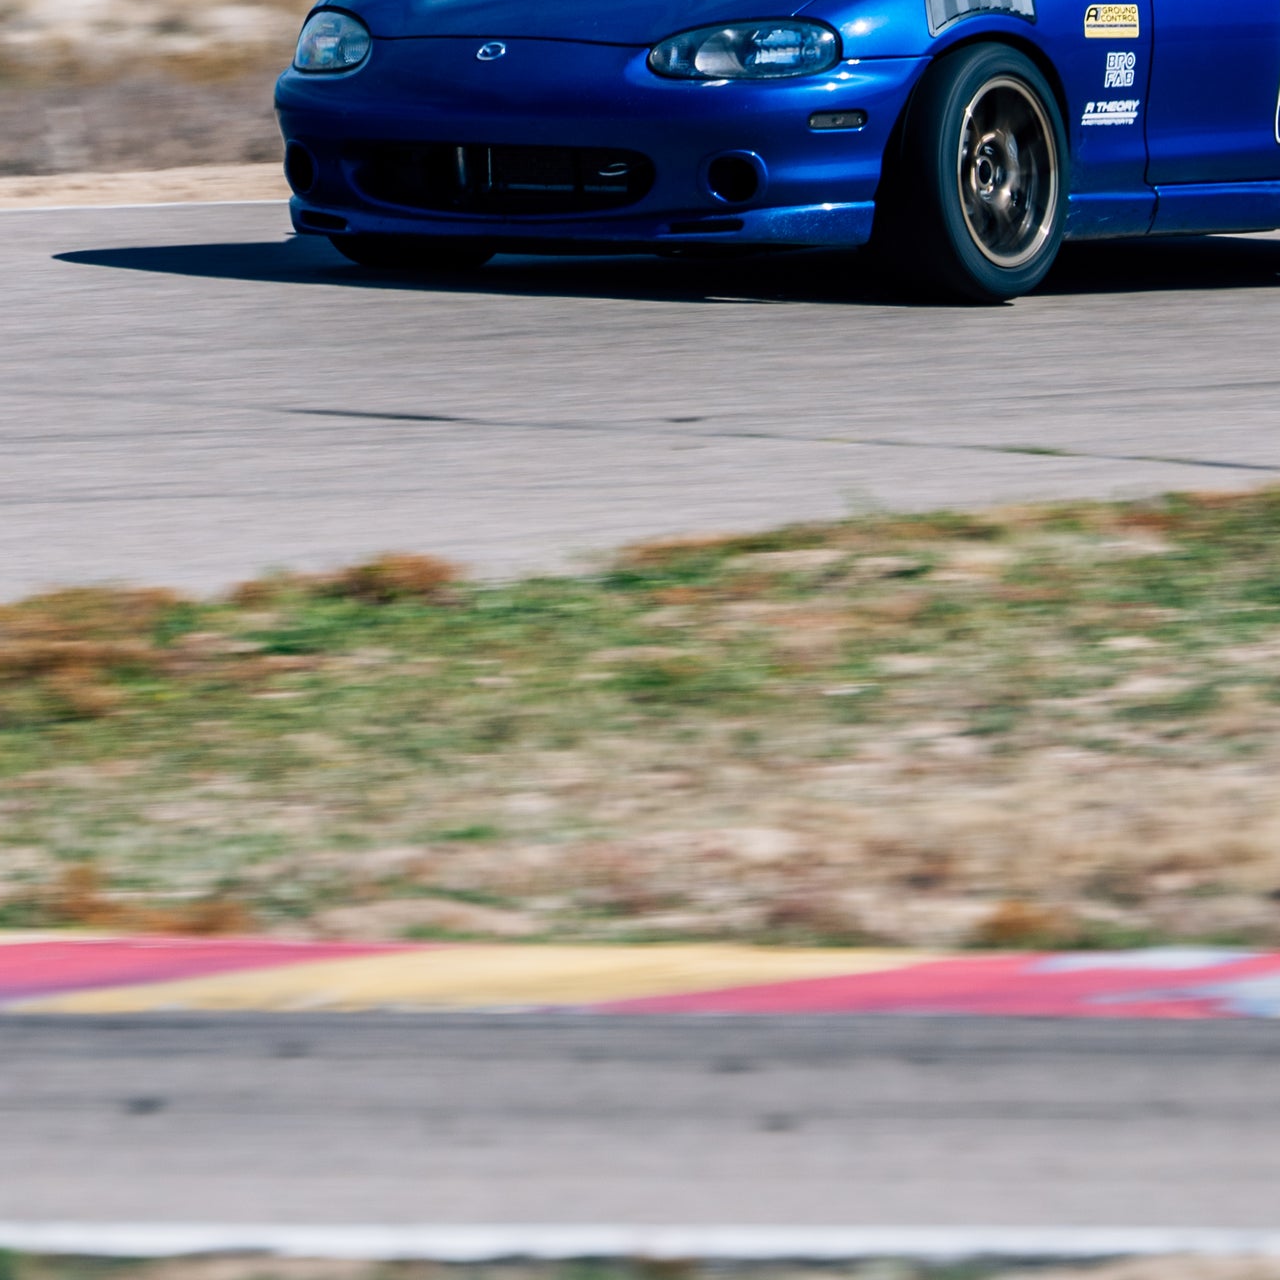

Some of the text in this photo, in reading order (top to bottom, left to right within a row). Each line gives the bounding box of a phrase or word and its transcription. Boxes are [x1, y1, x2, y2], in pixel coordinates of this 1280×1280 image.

[1102, 6, 1136, 14] GROUND
[1101, 14, 1136, 22] CONTROL
[1106, 52, 1135, 70] BRO
[1104, 69, 1134, 88] FAB
[1096, 99, 1140, 113] THEORY
